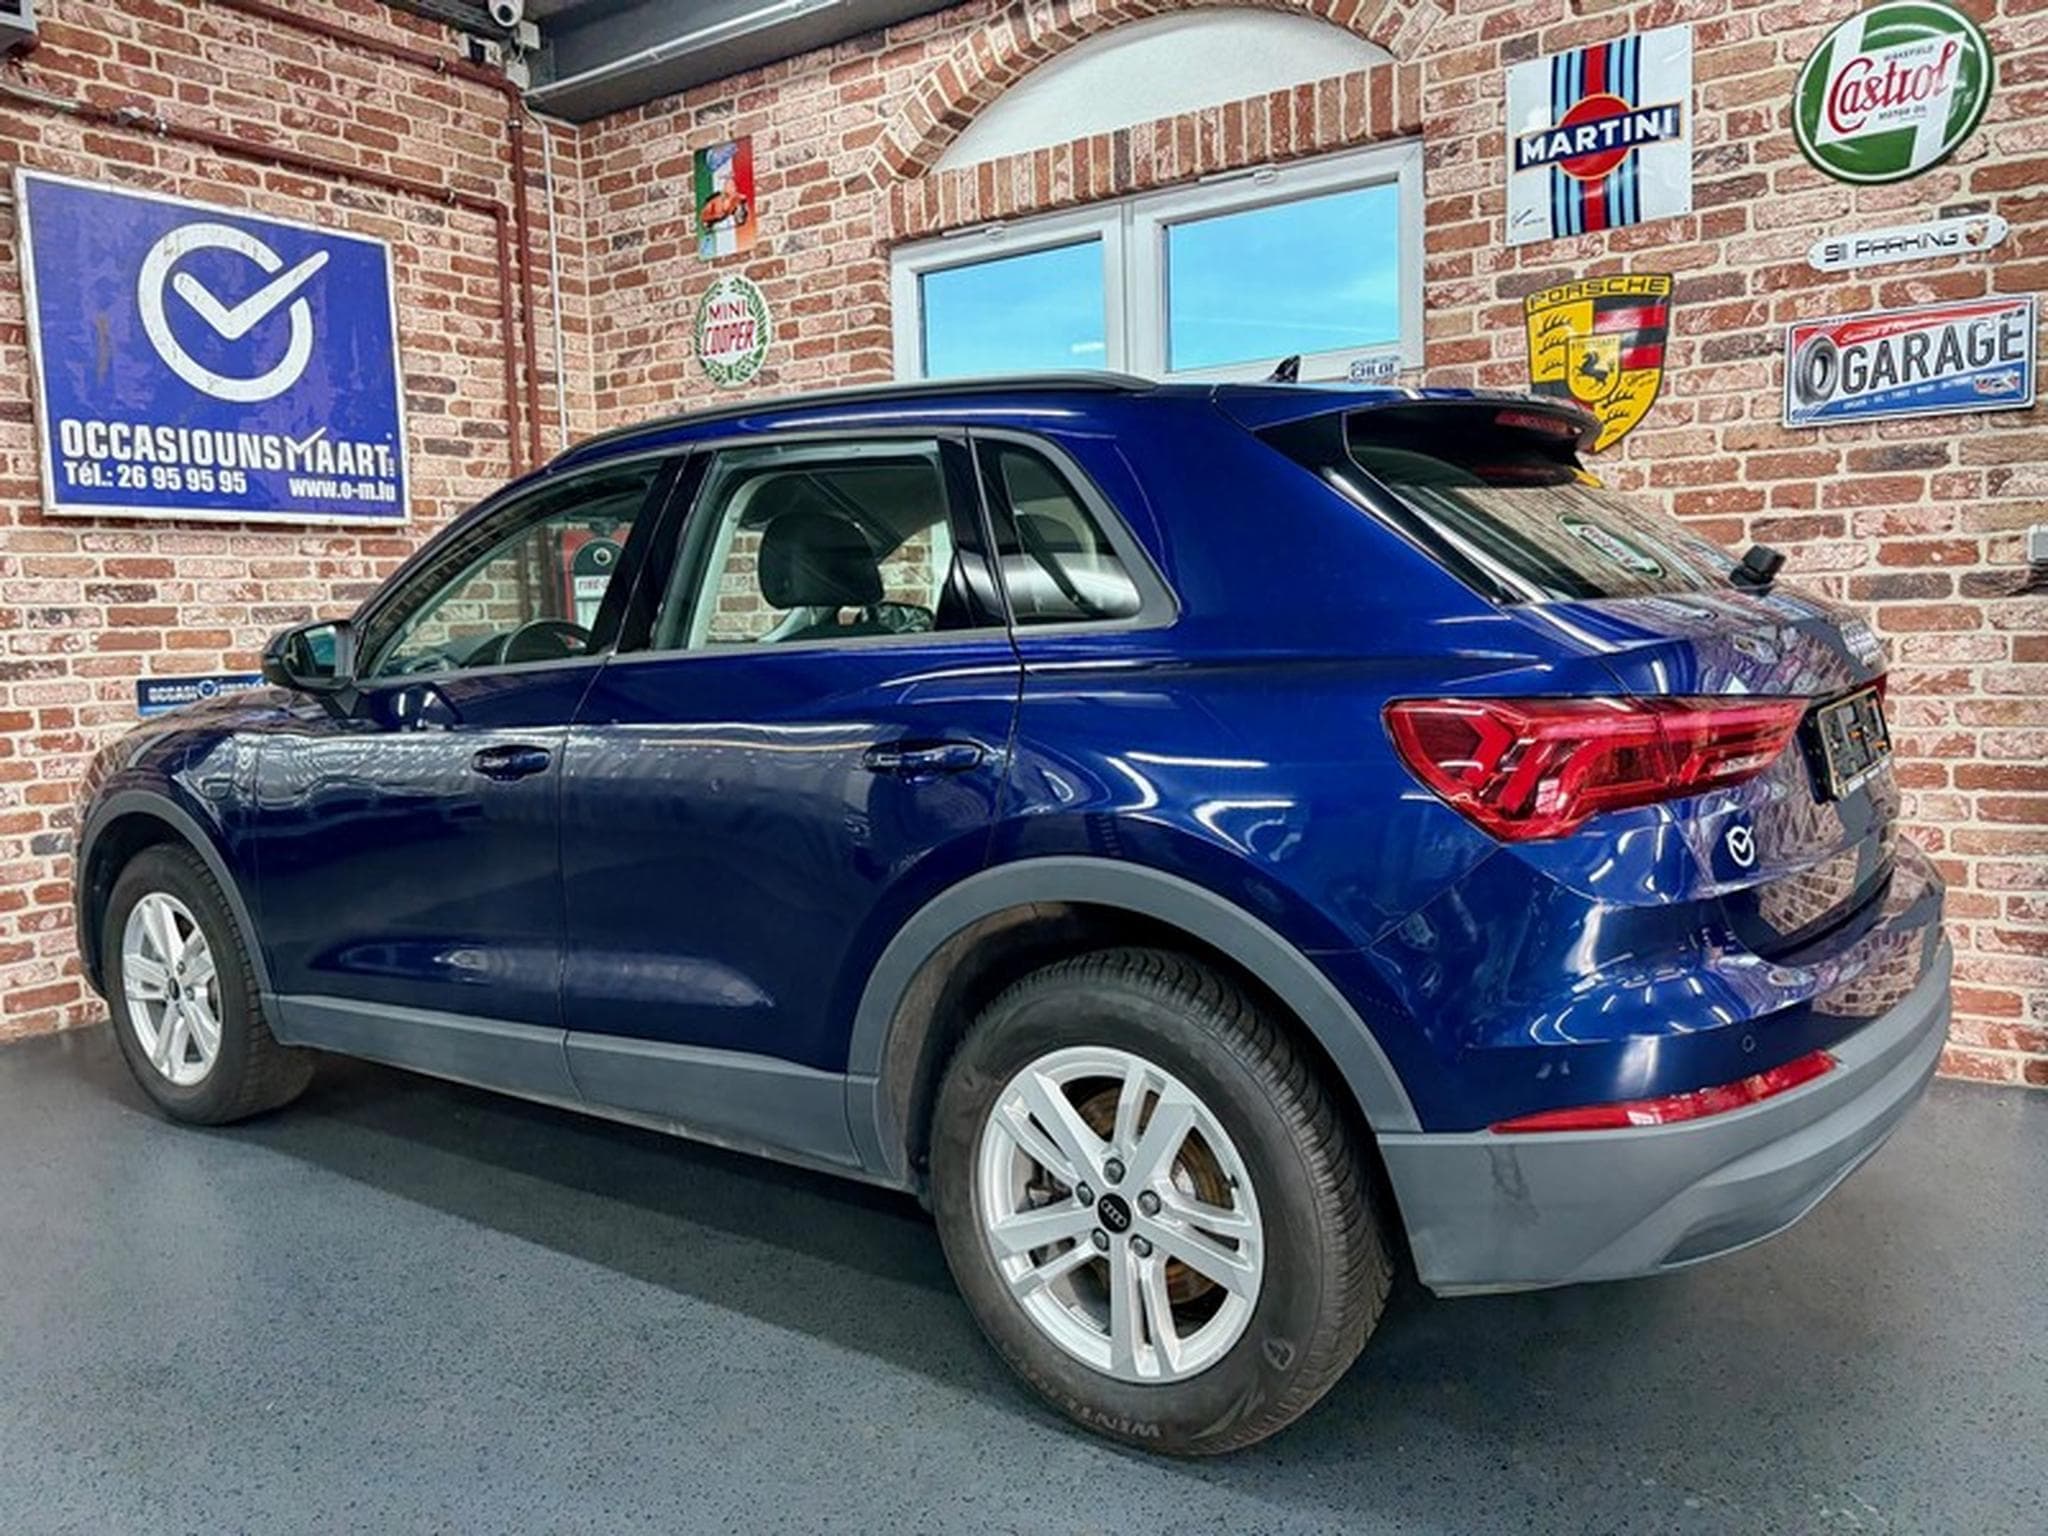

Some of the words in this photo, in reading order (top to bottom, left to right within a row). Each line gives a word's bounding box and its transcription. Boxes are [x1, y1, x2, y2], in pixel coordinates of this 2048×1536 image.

[1827, 40, 1959, 134] Castrol
[1521, 107, 1674, 166] MARTINI
[1855, 228, 1959, 259] PARKING
[708, 301, 747, 321] MINI
[1530, 278, 1666, 310] PORSCHE
[703, 320, 755, 356] COOPER
[1842, 320, 2025, 395] GARAGE
[60, 419, 389, 478] OCCASIOUNSMAART
[63, 461, 113, 487] Tél.:
[117, 464, 147, 488] 26
[151, 466, 181, 491] 95
[185, 468, 215, 493] 95
[219, 470, 247, 495] 95
[288, 477, 396, 501] www.o-m.lu
